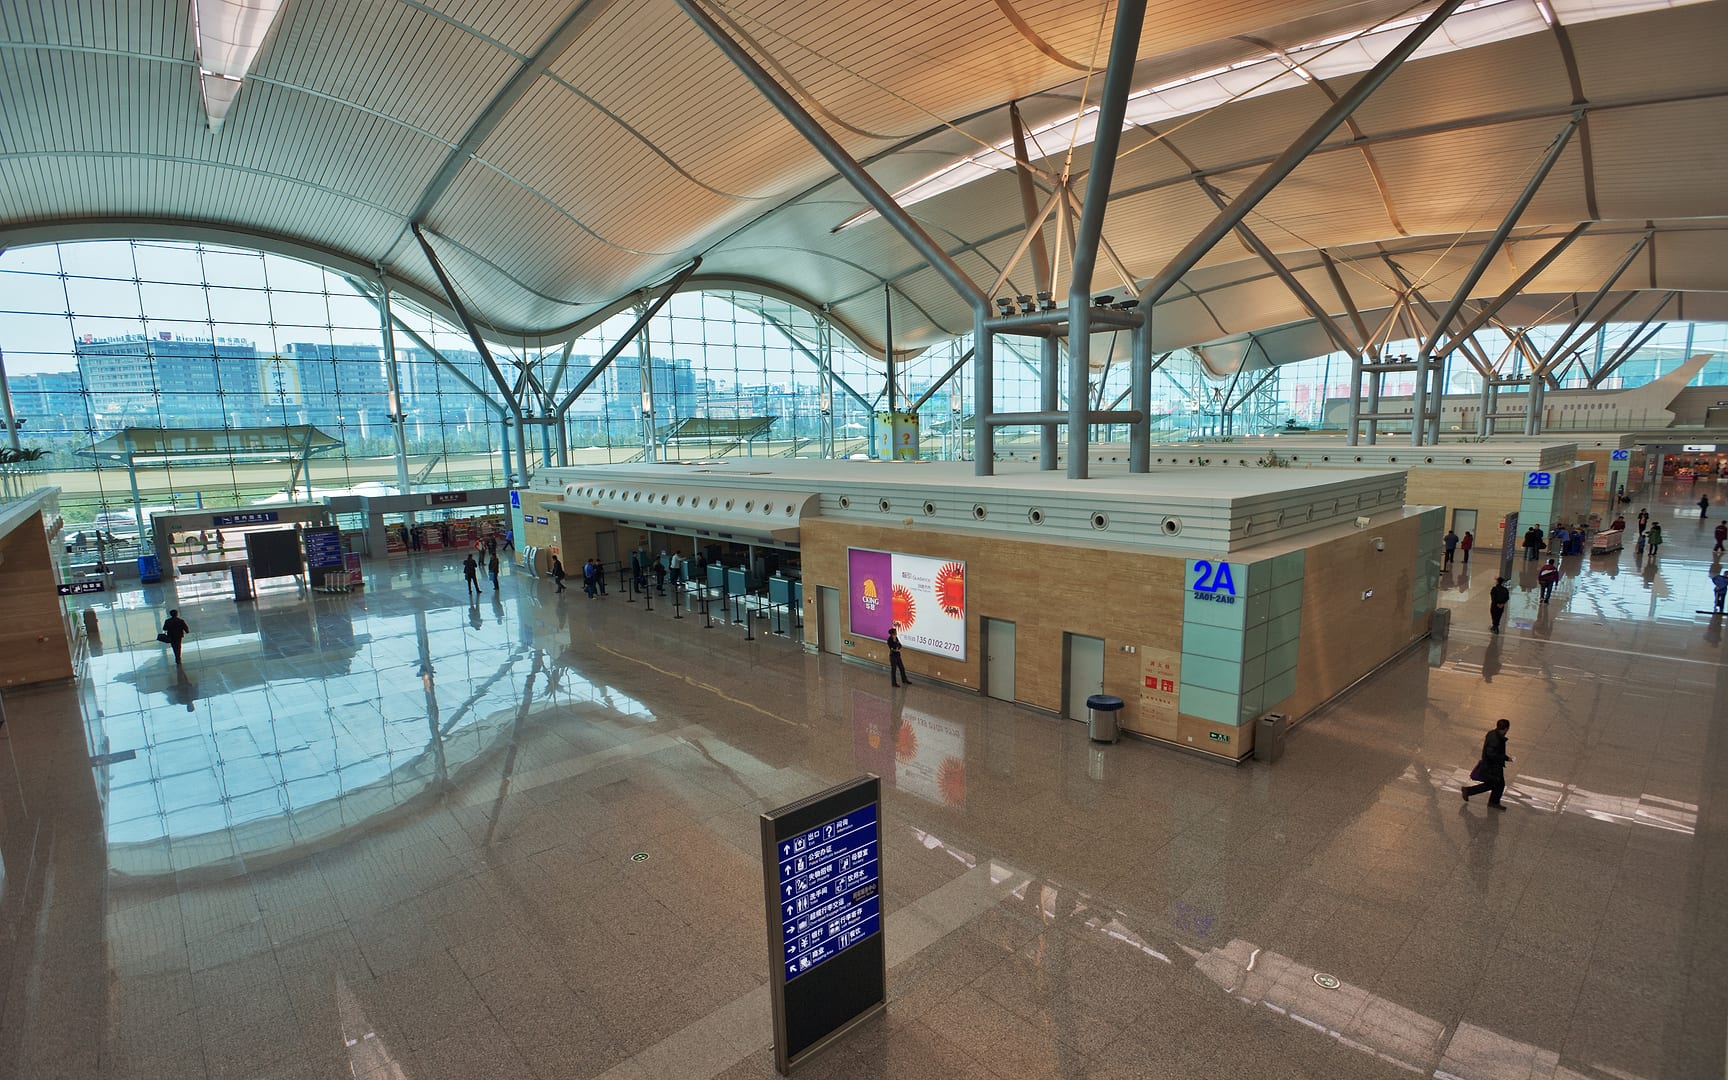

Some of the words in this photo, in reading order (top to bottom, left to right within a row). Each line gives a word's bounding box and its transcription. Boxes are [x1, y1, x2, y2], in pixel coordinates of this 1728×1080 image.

[1612, 449, 1628, 459] 2C
[1528, 472, 1550, 486] 2B
[1193, 560, 1236, 596] 2A
[1194, 592, 1235, 604] 2A01-2A10
[916, 635, 927, 644] 135
[928, 638, 943, 648] 0102
[944, 642, 960, 652] 2770
[808, 831, 820, 841] 出口
[808, 845, 832, 861] 公安办证
[848, 869, 864, 882] 饮用水
